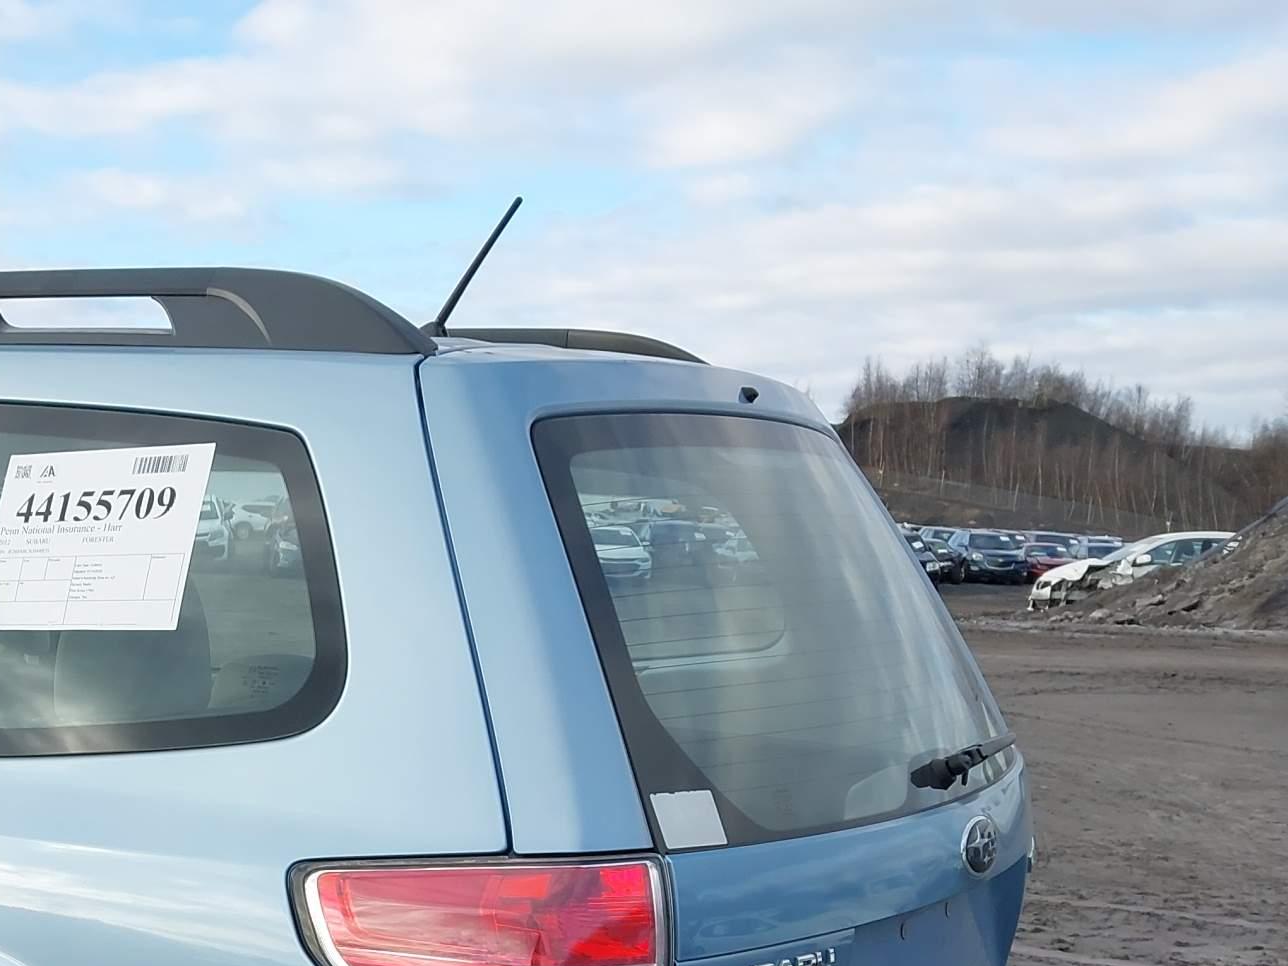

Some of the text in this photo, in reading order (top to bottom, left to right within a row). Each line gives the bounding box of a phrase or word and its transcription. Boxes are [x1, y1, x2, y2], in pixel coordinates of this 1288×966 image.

[16, 486, 177, 523] 44155709
[0, 527, 20, 536] Penn
[22, 525, 55, 535] National
[56, 523, 96, 534] Insurance
[103, 523, 123, 533] Harr
